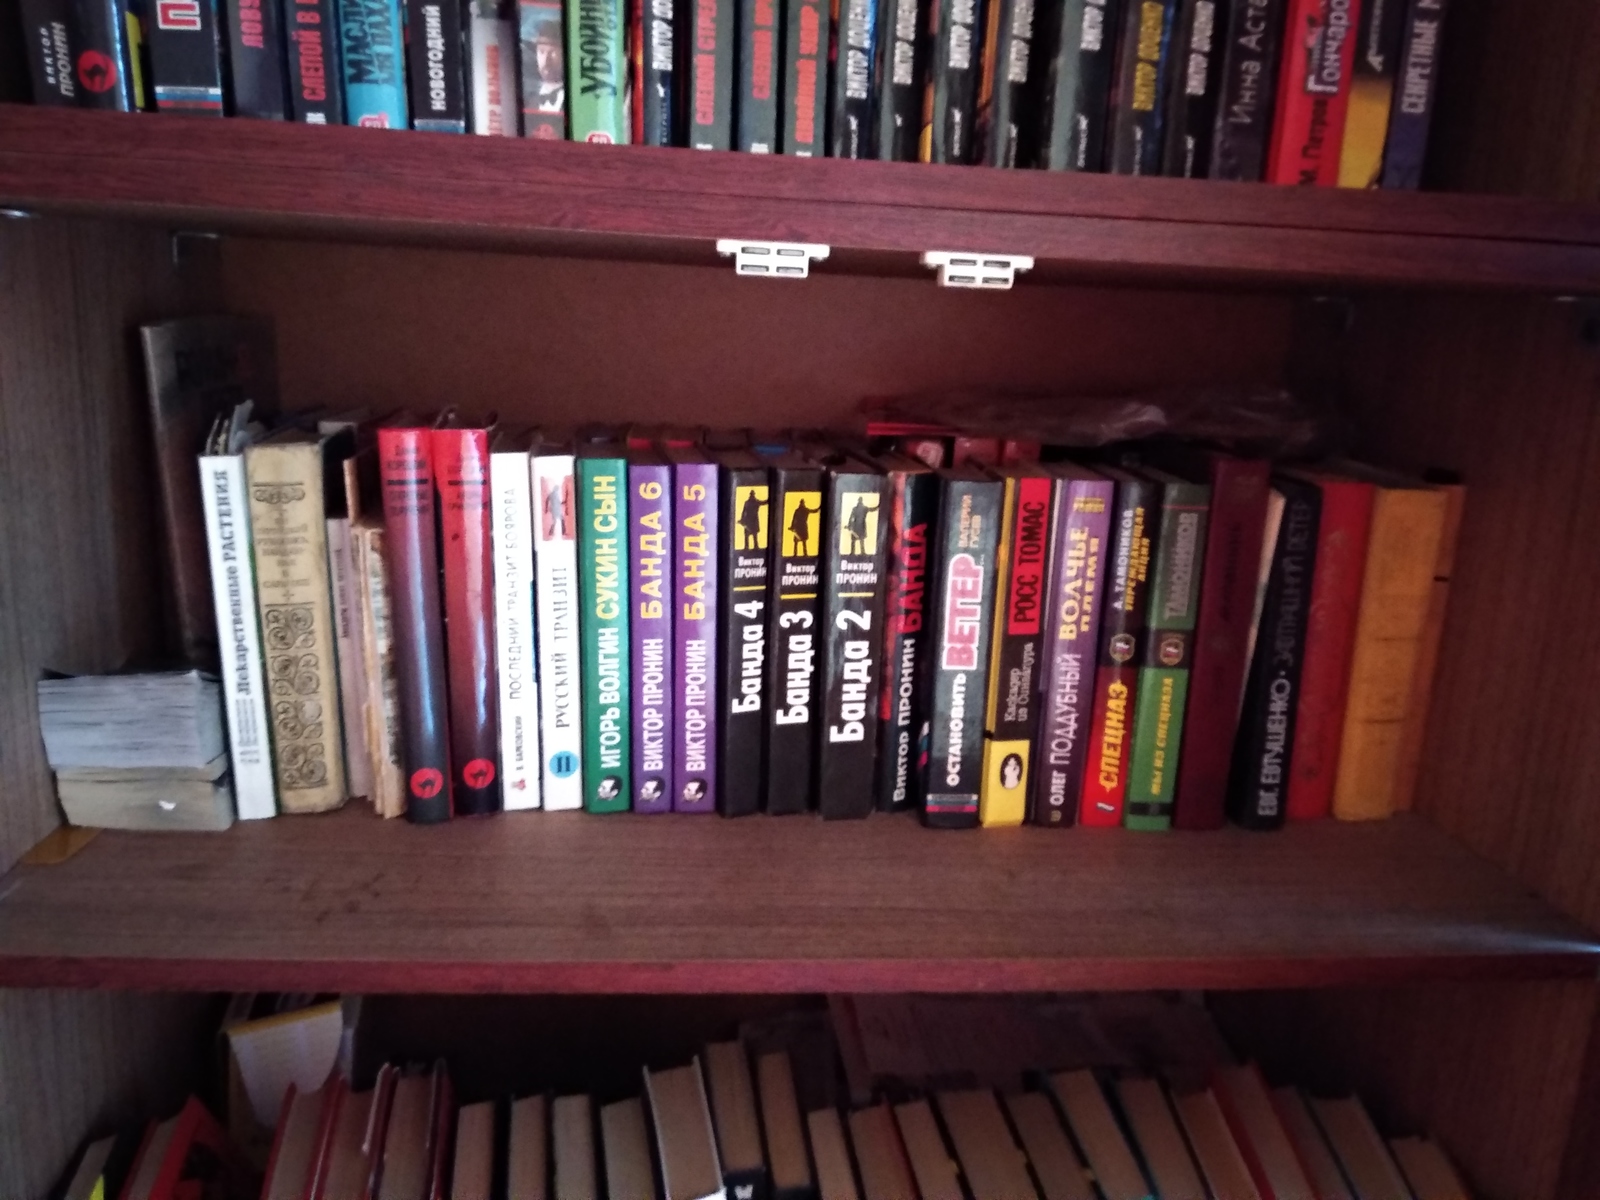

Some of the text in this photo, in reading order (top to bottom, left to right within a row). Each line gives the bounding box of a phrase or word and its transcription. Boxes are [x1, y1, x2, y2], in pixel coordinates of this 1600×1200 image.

[40, 27, 56, 84] ВИКТОР
[51, 22, 75, 97] ПРОНИН
[291, 29, 327, 101] СЛЕПОЙ
[421, 5, 447, 110] НОВОГОДНИЙ
[651, 20, 673, 71] ВИКТОР
[892, 41, 914, 85] ВИКТОР
[948, 24, 971, 69] ВИКТОР
[1007, 39, 1030, 83] ВИКТОР
[1079, 6, 1104, 51] ВИКТОР
[845, 49, 869, 99] ВИКТОР
[1132, 61, 1157, 111] ВИКТОР
[1185, 52, 1209, 96] ВИКТОР
[1227, 60, 1263, 125] Инна
[213, 469, 238, 562] РАСТЕНИЯ
[1115, 510, 1133, 593] ТАМОНИКОВ
[503, 489, 523, 700] ПОСЛЕДНИЙ ТРАНЗИТ БОЯРОВА
[734, 568, 766, 579] ПРОНИН
[738, 556, 764, 567] Виктор
[782, 575, 818, 586] ПРОНИН
[786, 563, 815, 574] Виктор
[836, 573, 877, 584] ПРОНИН
[841, 560, 873, 571] Виктор
[1013, 502, 1045, 622] РОСС ТОМАС
[1059, 527, 1089, 640] ВОЛЧЬЕ
[1080, 537, 1099, 632] ПЛЕМЯ
[1163, 512, 1198, 619] ТАМОНИКОВ
[228, 565, 252, 695] Лекарственные
[593, 476, 622, 768] ИГОРЬ ВОЛГИН СУКИН СЫН
[639, 482, 666, 771] ВИКТОР ПРОНИН БАНДА 6
[684, 484, 709, 772] ВИКТОР ПРОНИН БАНДА 5
[731, 601, 765, 714] Банда 4
[893, 522, 928, 801] Виктор ПРОНИН БАНДА
[551, 652, 570, 728] РУССКИЙ
[776, 611, 815, 725] Банда 3
[830, 610, 873, 742] Банда 2
[942, 554, 984, 786] ОСТАНОВИТЬ ВЕТЕР
[1050, 654, 1081, 806] ОЛЕГ ПОДДУБНЫЙ
[1099, 683, 1128, 789] СПЕЦНАЗ
[1260, 679, 1292, 784] ЕВТУШЕНКО
